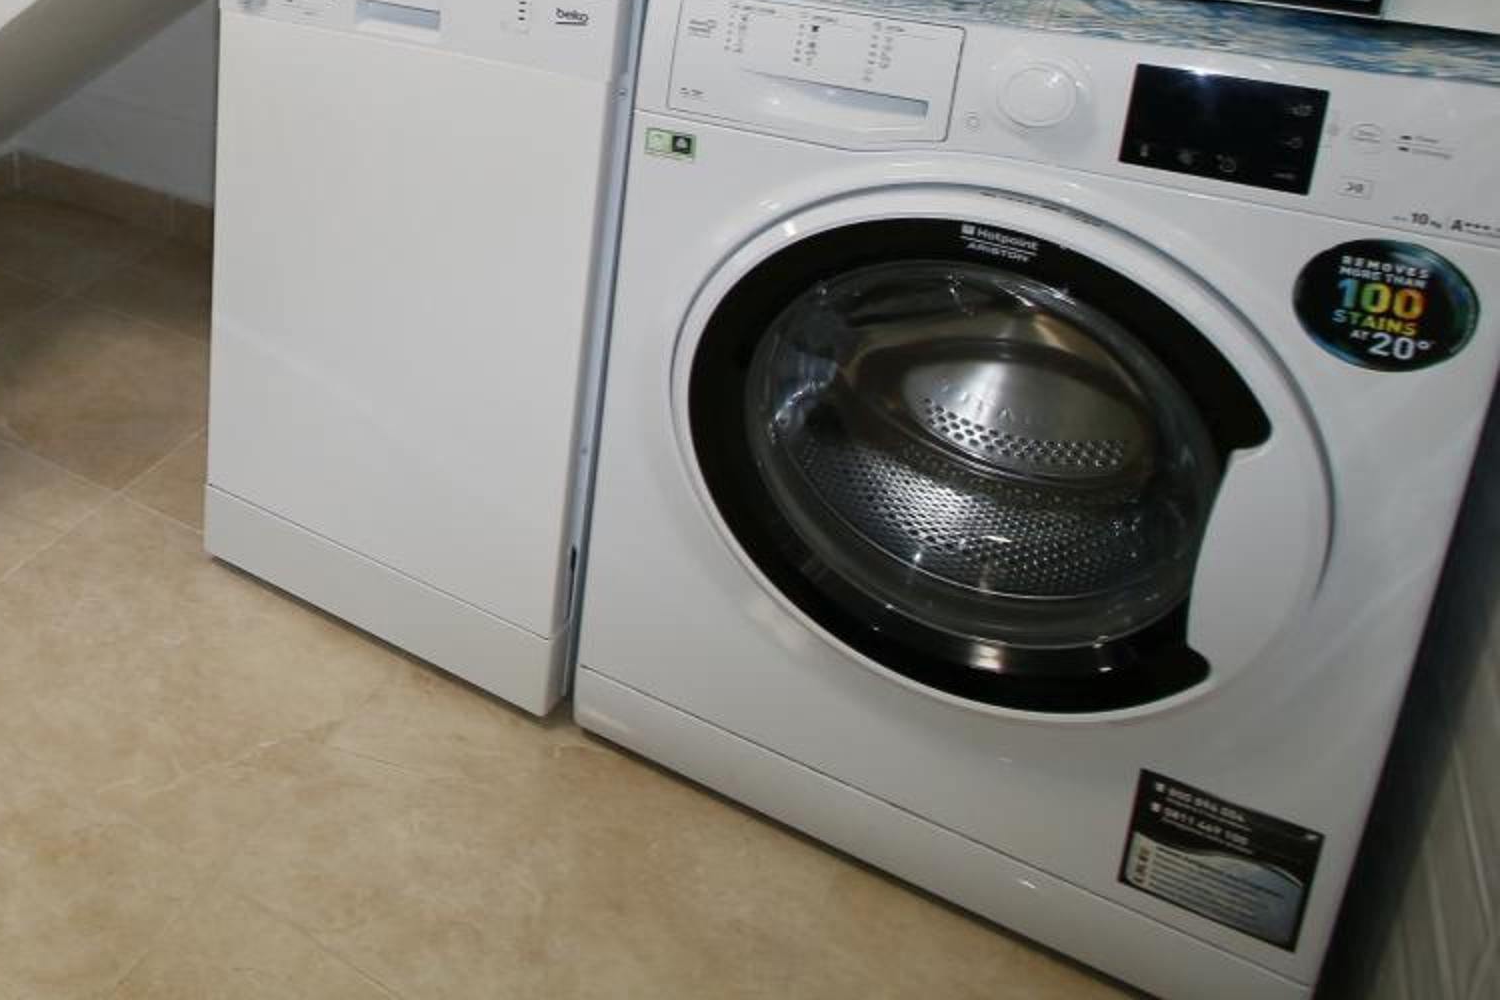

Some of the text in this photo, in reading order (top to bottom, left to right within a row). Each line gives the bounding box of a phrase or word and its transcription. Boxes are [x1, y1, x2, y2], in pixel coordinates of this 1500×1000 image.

[556, 7, 589, 22] beko
[977, 227, 1038, 250] Hotpoint
[1338, 266, 1426, 288] MORE THAN
[1341, 256, 1429, 279] REMOVES
[1338, 279, 1425, 320] 100
[1331, 309, 1417, 336] STAINS
[1350, 329, 1371, 340] AT
